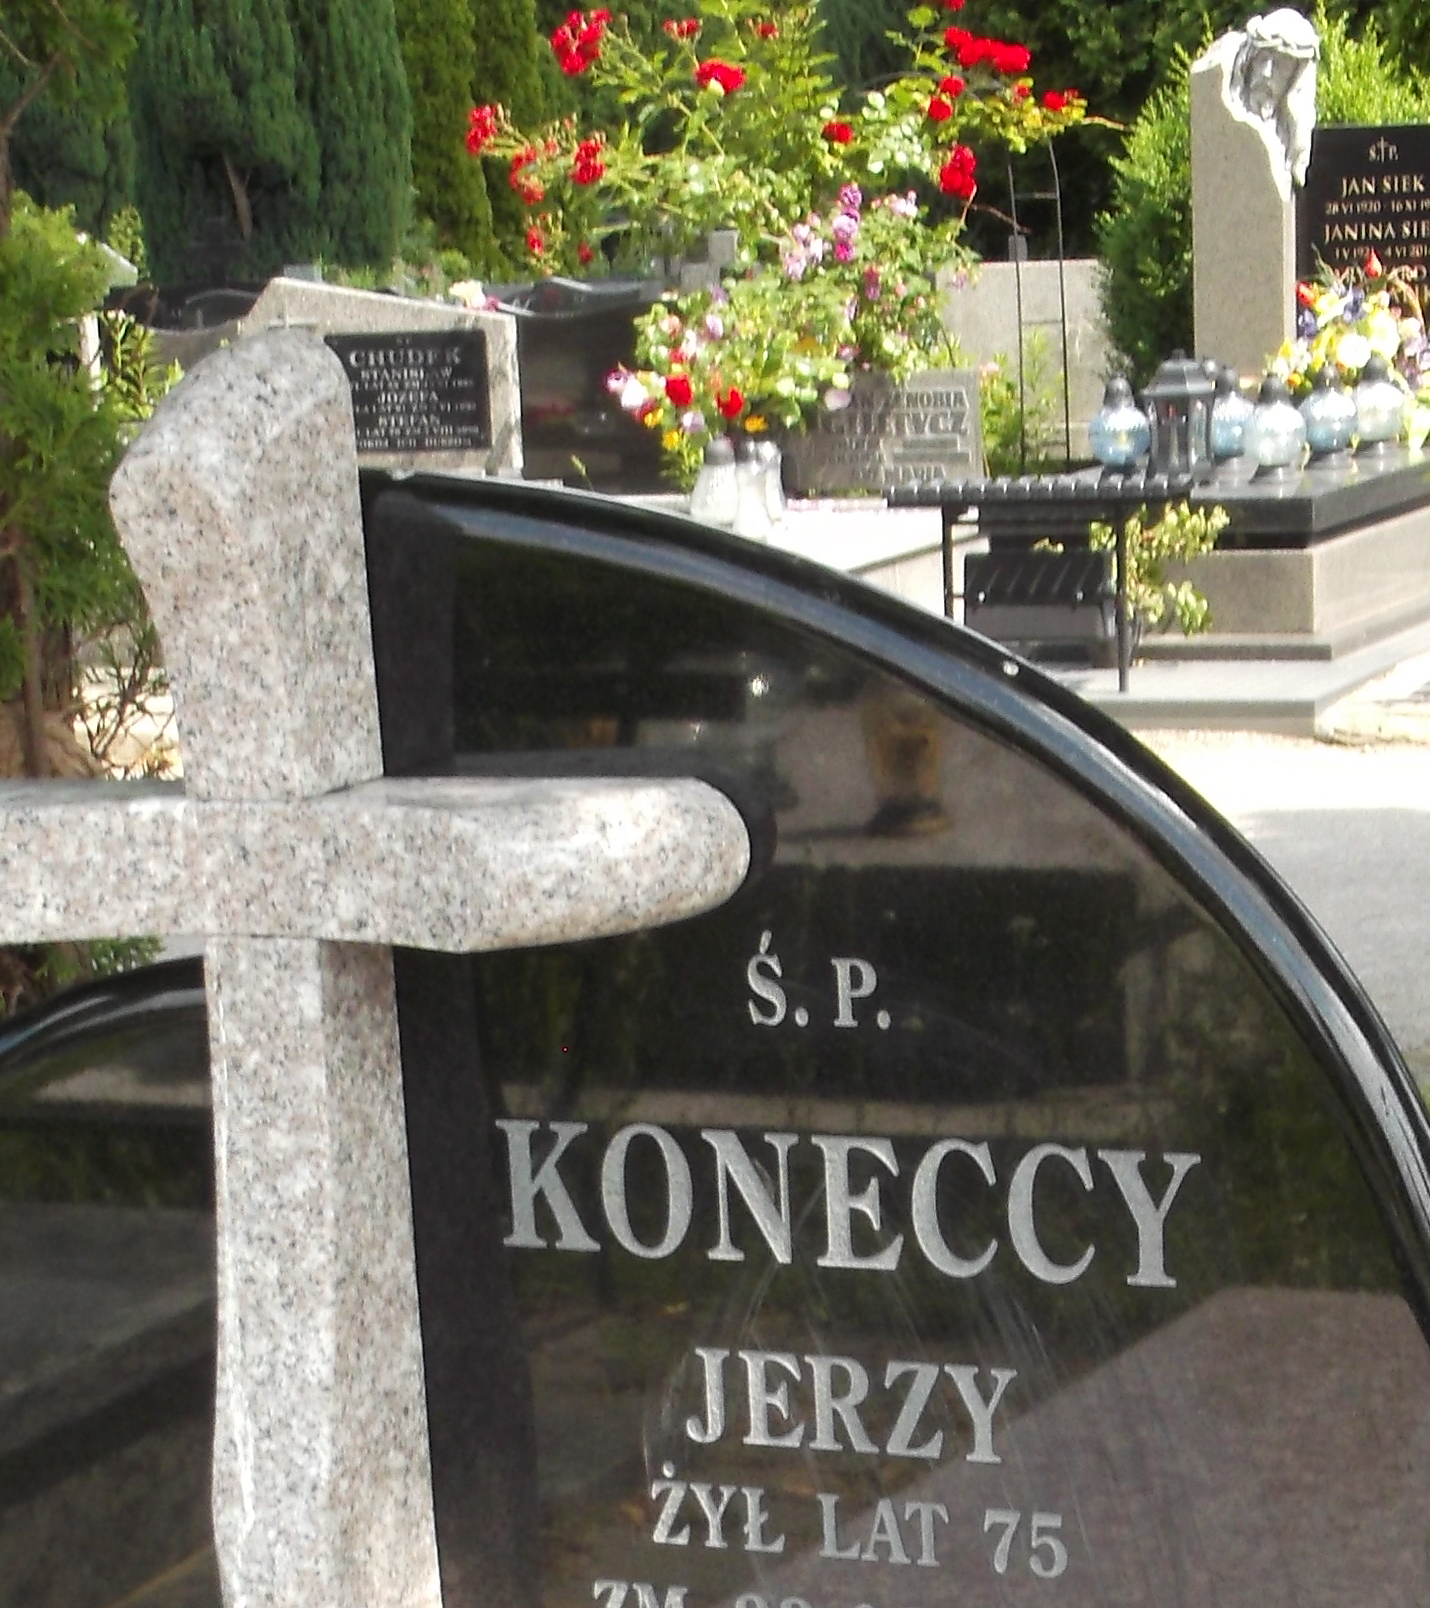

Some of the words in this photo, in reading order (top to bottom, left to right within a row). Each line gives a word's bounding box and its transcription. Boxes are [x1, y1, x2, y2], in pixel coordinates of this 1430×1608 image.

[1324, 221, 1396, 245] JANINA
[1342, 176, 1376, 198] JAN
[1383, 174, 1426, 193] SIEK
[748, 932, 809, 1029] Ś.
[831, 956, 891, 1031] P.
[495, 1118, 1202, 1288] KONECCY
[685, 1346, 1017, 1465] JERZY
[651, 1461, 785, 1554] ŻYŁ
[818, 1493, 949, 1568] LAT
[983, 1508, 1068, 1579] 75
